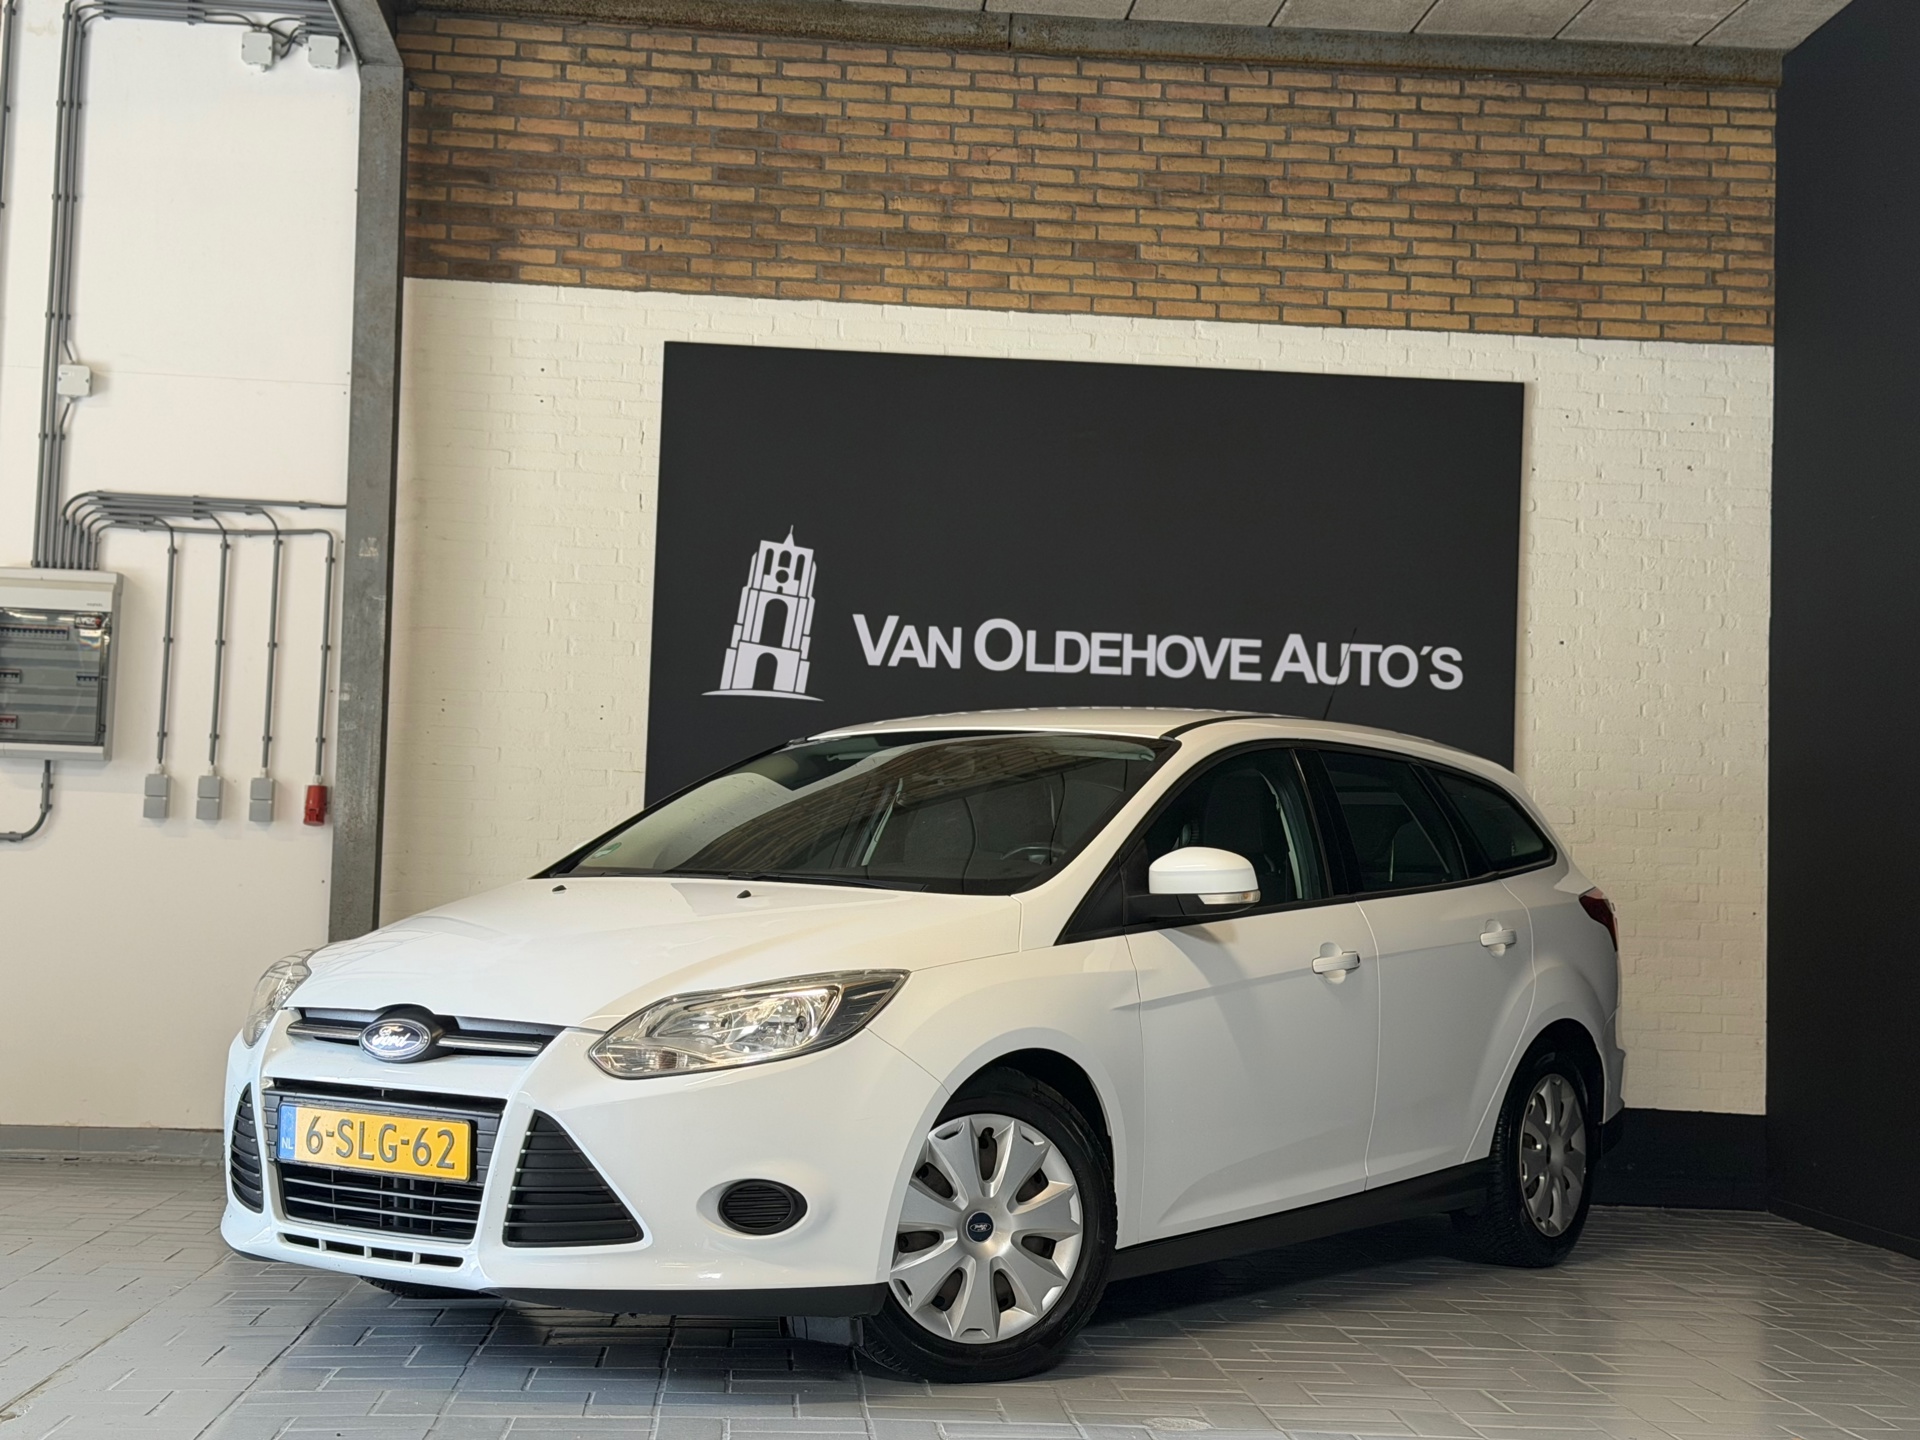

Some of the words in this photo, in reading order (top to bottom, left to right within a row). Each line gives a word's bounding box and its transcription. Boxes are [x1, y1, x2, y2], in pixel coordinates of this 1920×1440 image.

[852, 613, 962, 669] VAN
[973, 617, 1263, 682] OLDEHOVE
[371, 1025, 412, 1048] Ford
[281, 1137, 294, 1150] NL
[306, 1115, 455, 1169] 6-SLG-62
